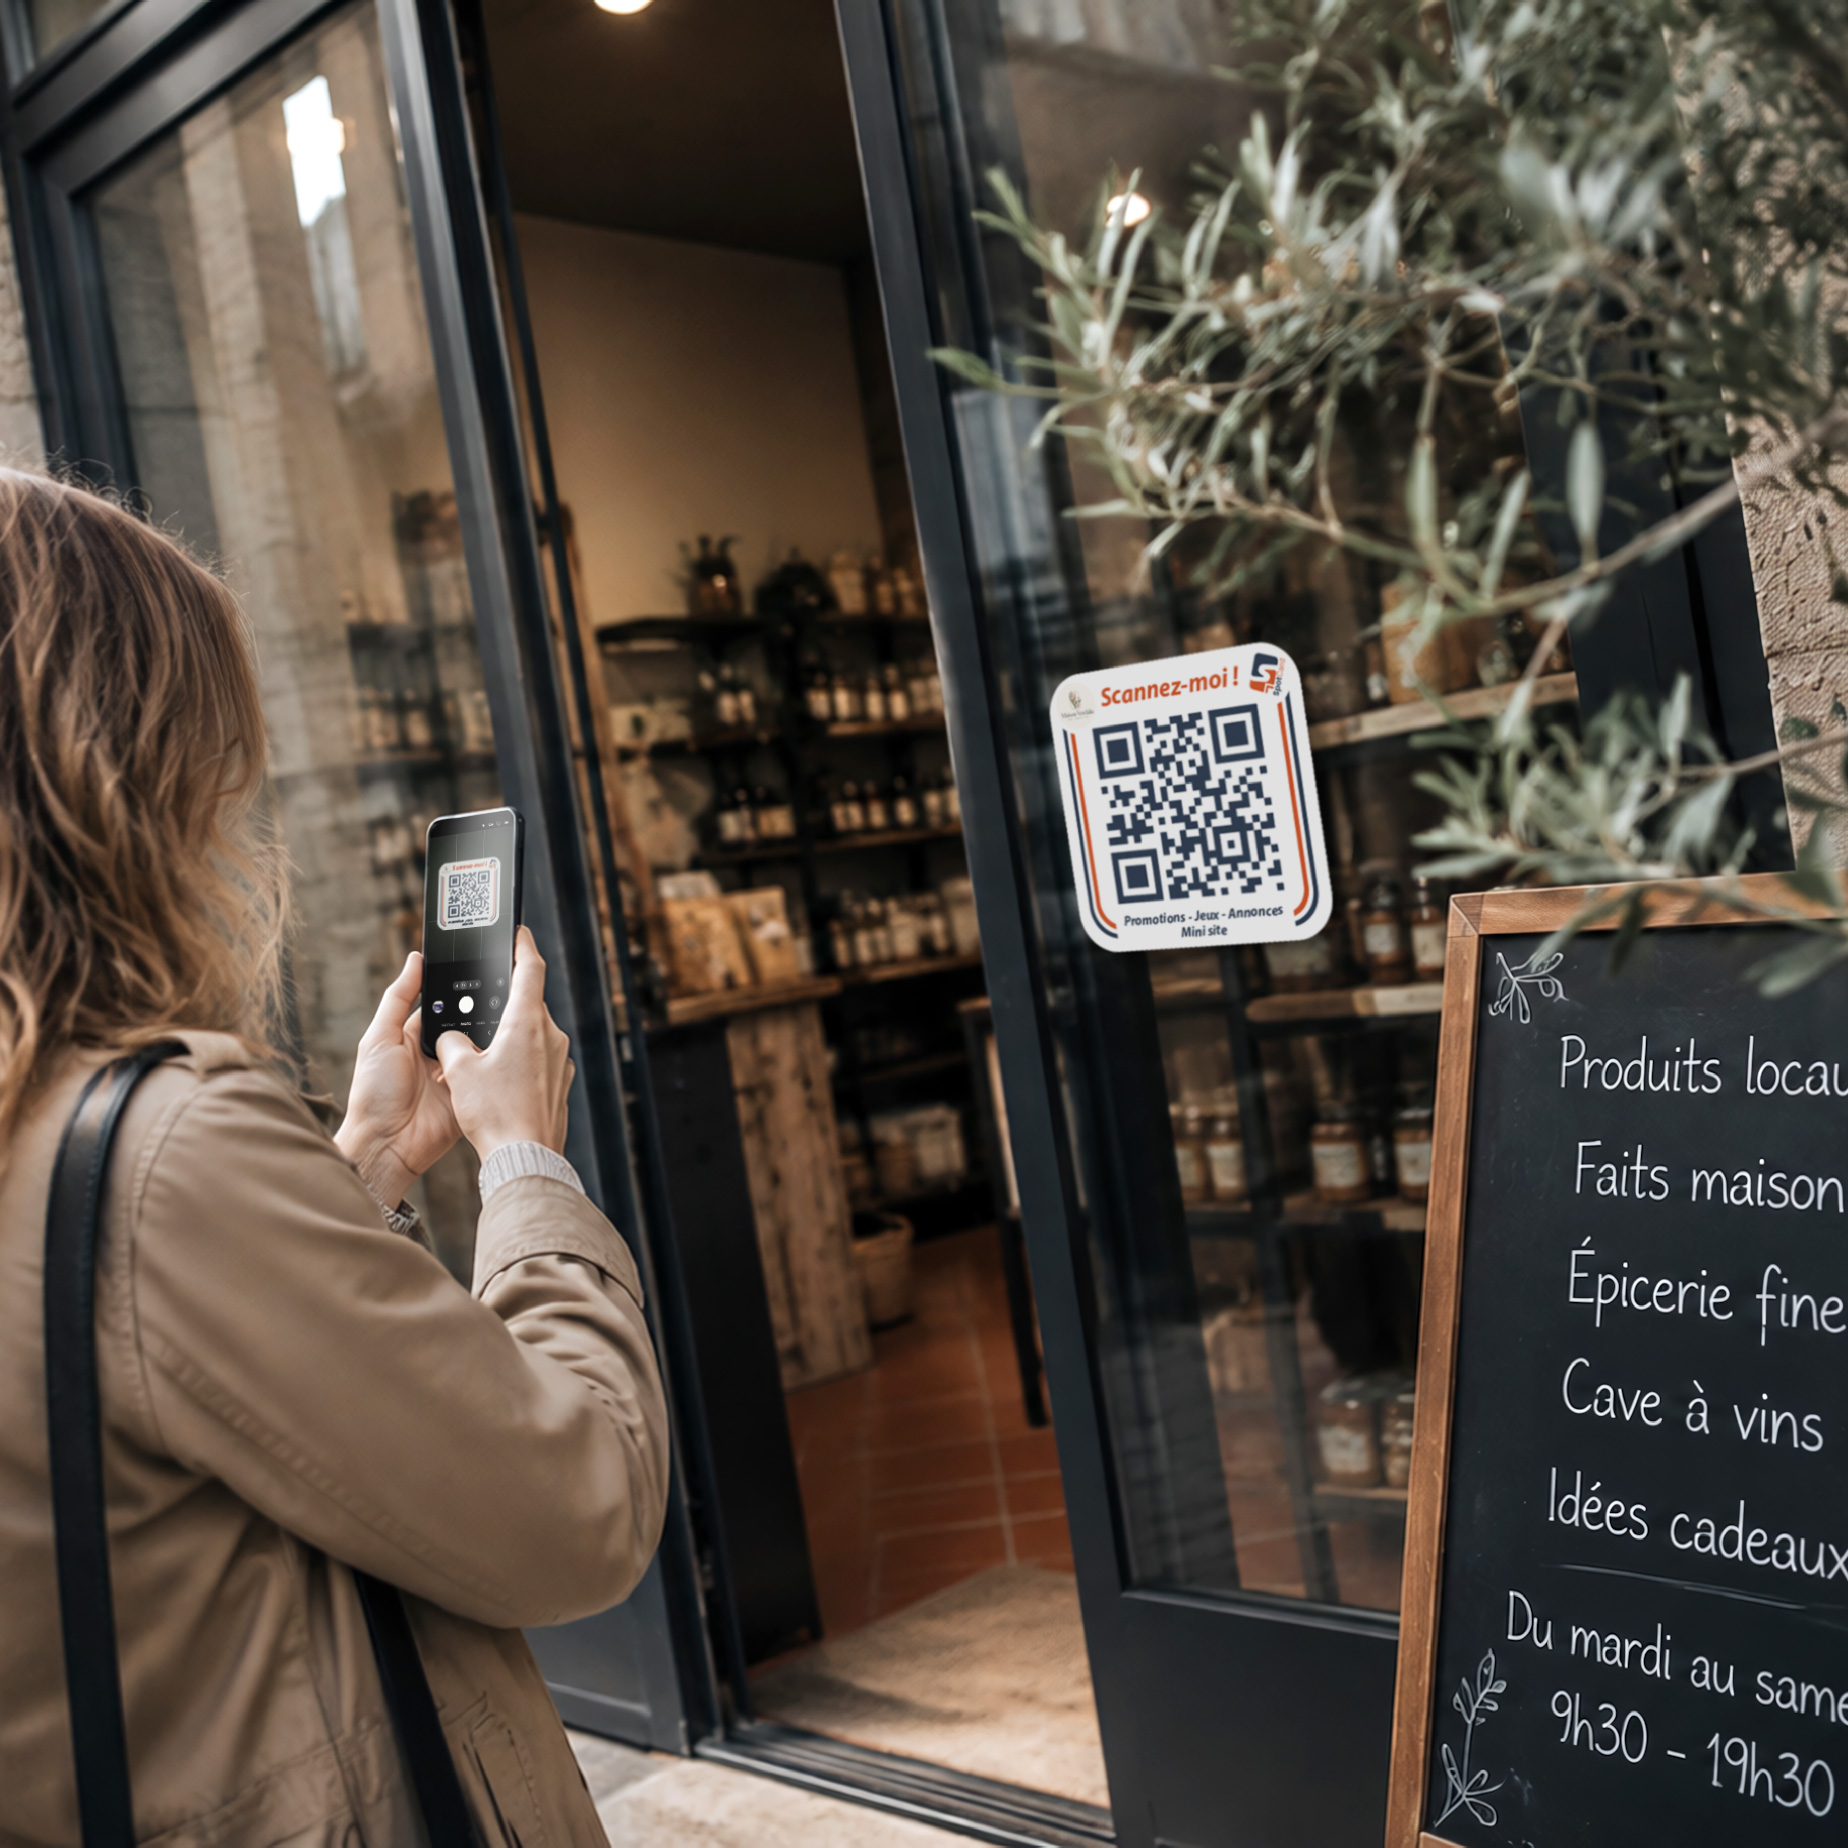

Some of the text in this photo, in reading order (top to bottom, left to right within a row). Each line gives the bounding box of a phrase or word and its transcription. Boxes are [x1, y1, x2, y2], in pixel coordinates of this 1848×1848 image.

[1101, 666, 1239, 706] Scannez-moi !
[1124, 912, 1186, 926] Promotions
[1194, 910, 1220, 922] Jeux
[1228, 906, 1284, 919] Annonces
[1181, 924, 1228, 938] Mini site
[1560, 1034, 1722, 1094] Produits
[1575, 1140, 1845, 1214] Faits maison
[1568, 1235, 1847, 1347] Épicerie fine
[1562, 1357, 1824, 1452] Cave à vins
[1548, 1466, 1848, 1581] Idées cadeaux
[1507, 1590, 1553, 1650] Du
[1570, 1622, 1671, 1681] mardi
[1690, 1655, 1735, 1697] au
[1551, 1690, 1648, 1763] 9h30
[1706, 1732, 1835, 1817] 19h30
